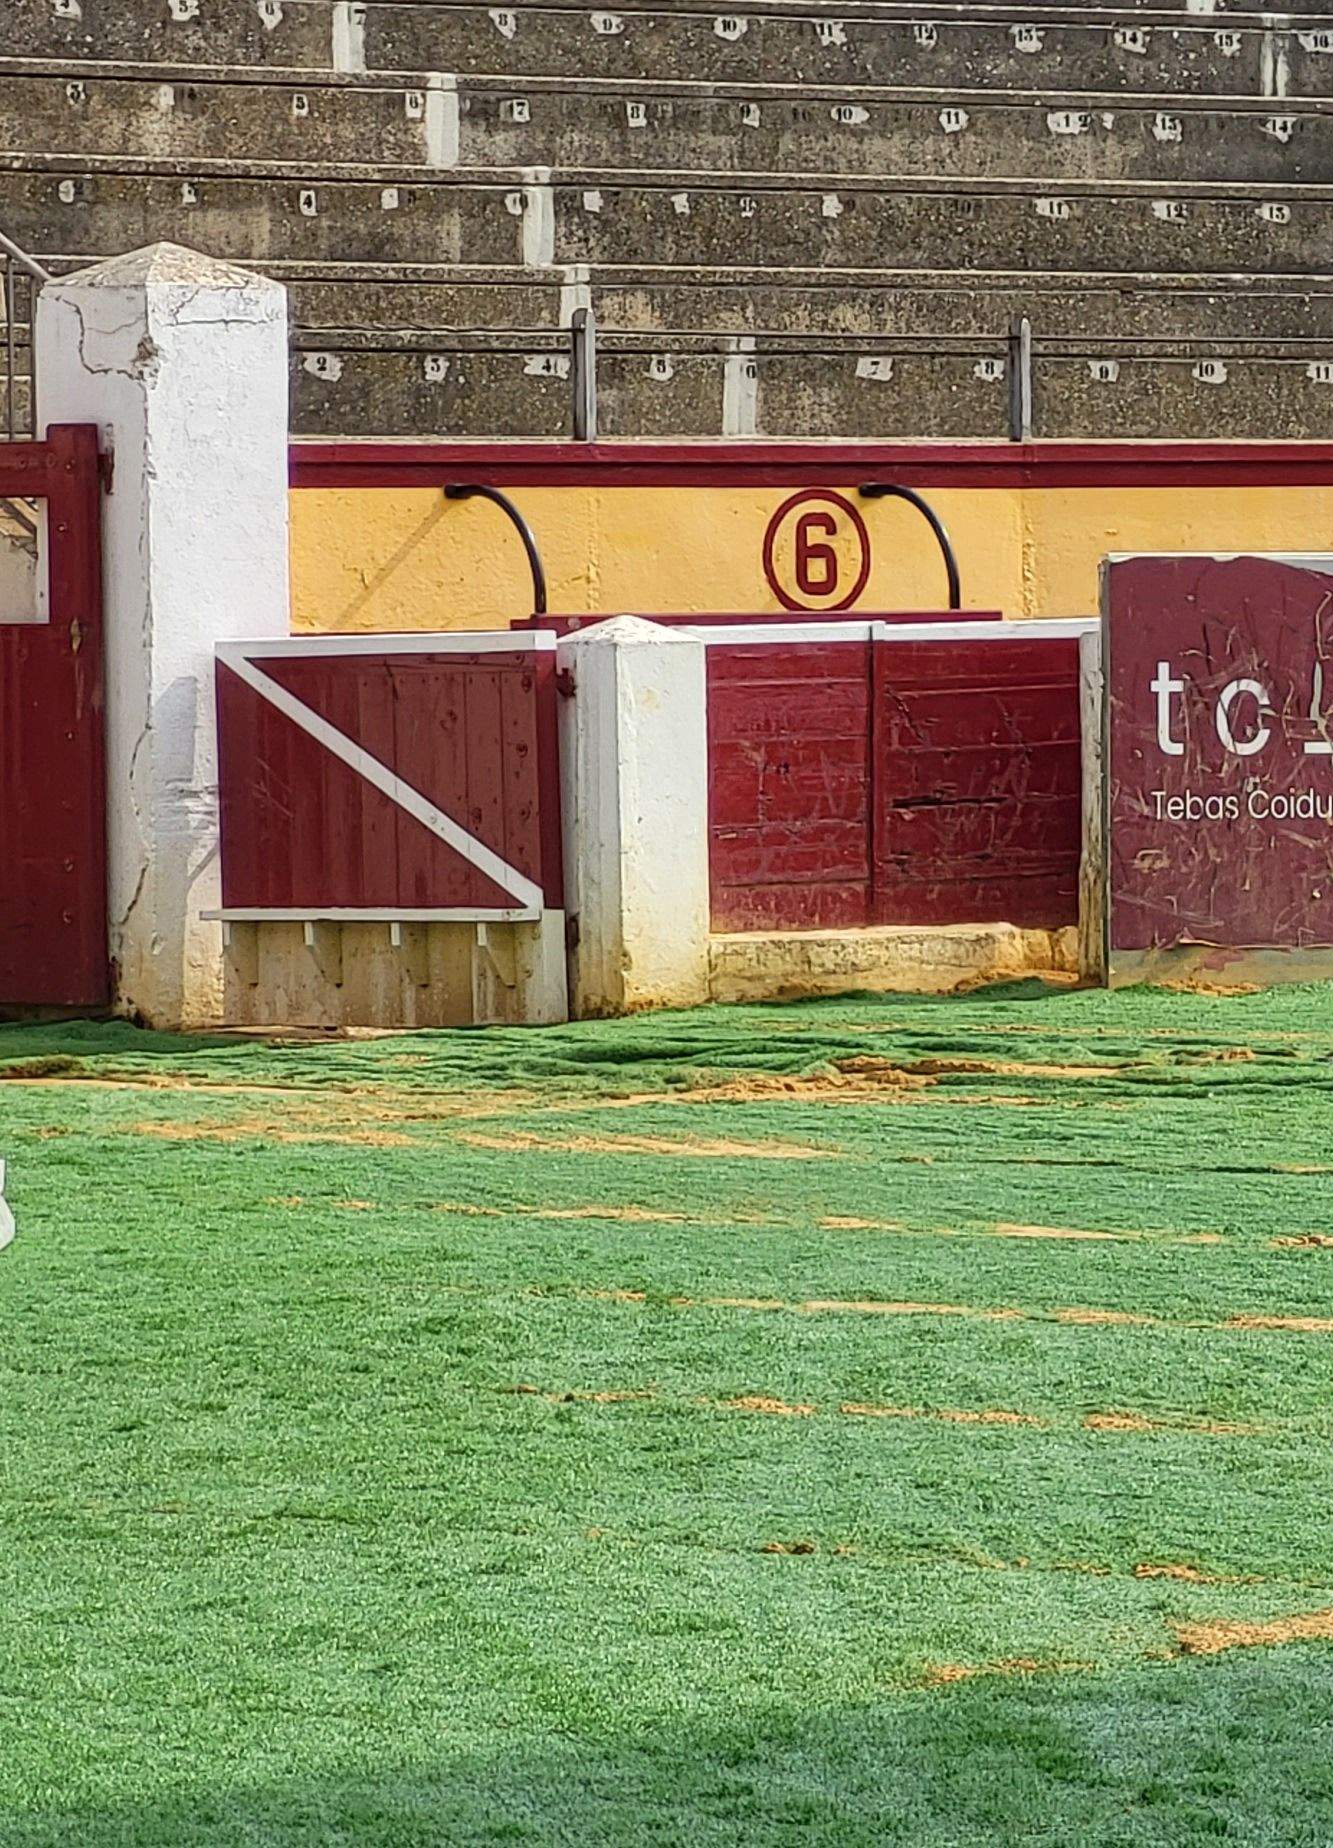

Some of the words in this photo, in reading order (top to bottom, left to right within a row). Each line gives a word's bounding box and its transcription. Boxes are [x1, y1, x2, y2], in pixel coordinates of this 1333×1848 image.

[946, 111, 960, 124] 11
[796, 512, 837, 595] 6
[1151, 790, 1239, 821] Tebas
